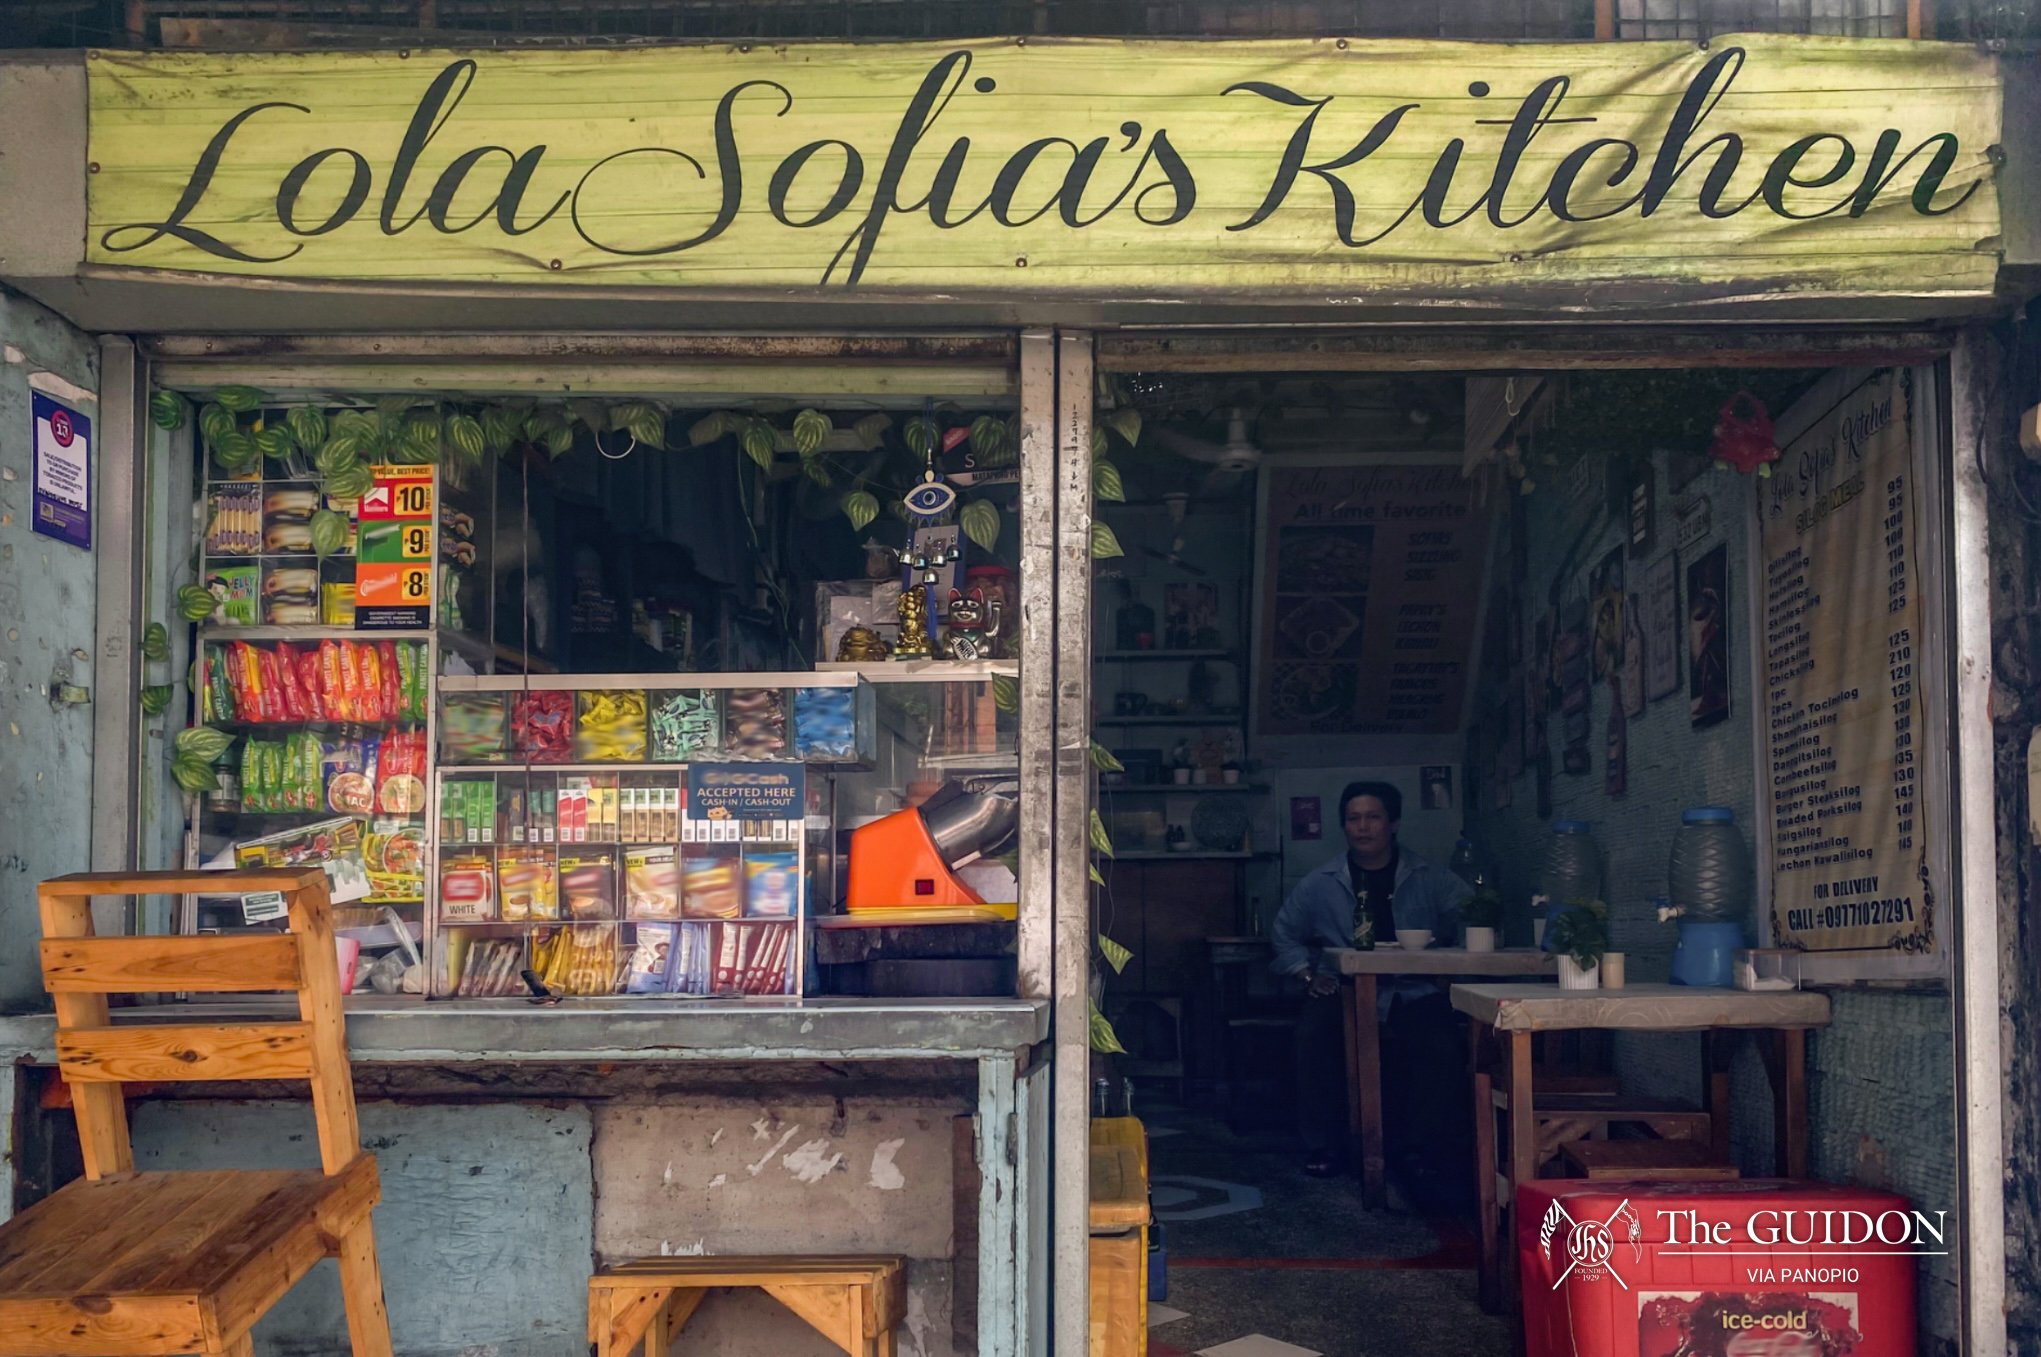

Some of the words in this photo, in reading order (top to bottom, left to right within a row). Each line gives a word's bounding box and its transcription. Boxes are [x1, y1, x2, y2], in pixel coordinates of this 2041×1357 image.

[101, 59, 572, 263] Lola
[572, 50, 1197, 287] Sofia's
[1220, 46, 1982, 248] Kitchen
[397, 467, 411, 475] BEST
[1887, 475, 1903, 494] 95
[1383, 501, 1467, 518] favorite
[1888, 493, 1903, 512] 95
[1884, 510, 1903, 530] 100
[1885, 527, 1903, 547] 100
[1888, 544, 1904, 562] 110
[1889, 560, 1905, 579] 110
[1888, 578, 1906, 597] 125
[1888, 595, 1906, 614] 125
[419, 644, 428, 668] CANTON
[1771, 687, 1787, 702] 1pc
[1888, 628, 1910, 648] 125
[1889, 646, 1911, 665] 210
[419, 668, 427, 689] PANCIT
[1890, 663, 1911, 682] 120
[1891, 681, 1912, 699] 125
[1892, 698, 1911, 715] 130
[1894, 715, 1910, 732] 130
[1895, 732, 1912, 749] 130
[1895, 749, 1913, 765] 135
[1894, 766, 1915, 783] 130
[696, 787, 761, 797] ACCEPTED
[764, 787, 796, 797] HERE
[1817, 800, 1863, 820] Porksilog
[1894, 783, 1914, 800] 145
[1895, 801, 1913, 817] 140
[1813, 884, 1829, 899] FOR
[1832, 875, 1879, 897] DELIVERY
[449, 904, 475, 914] WHITE
[1787, 908, 1814, 931] CALL
[1722, 1310, 1807, 1330] ice-cold
